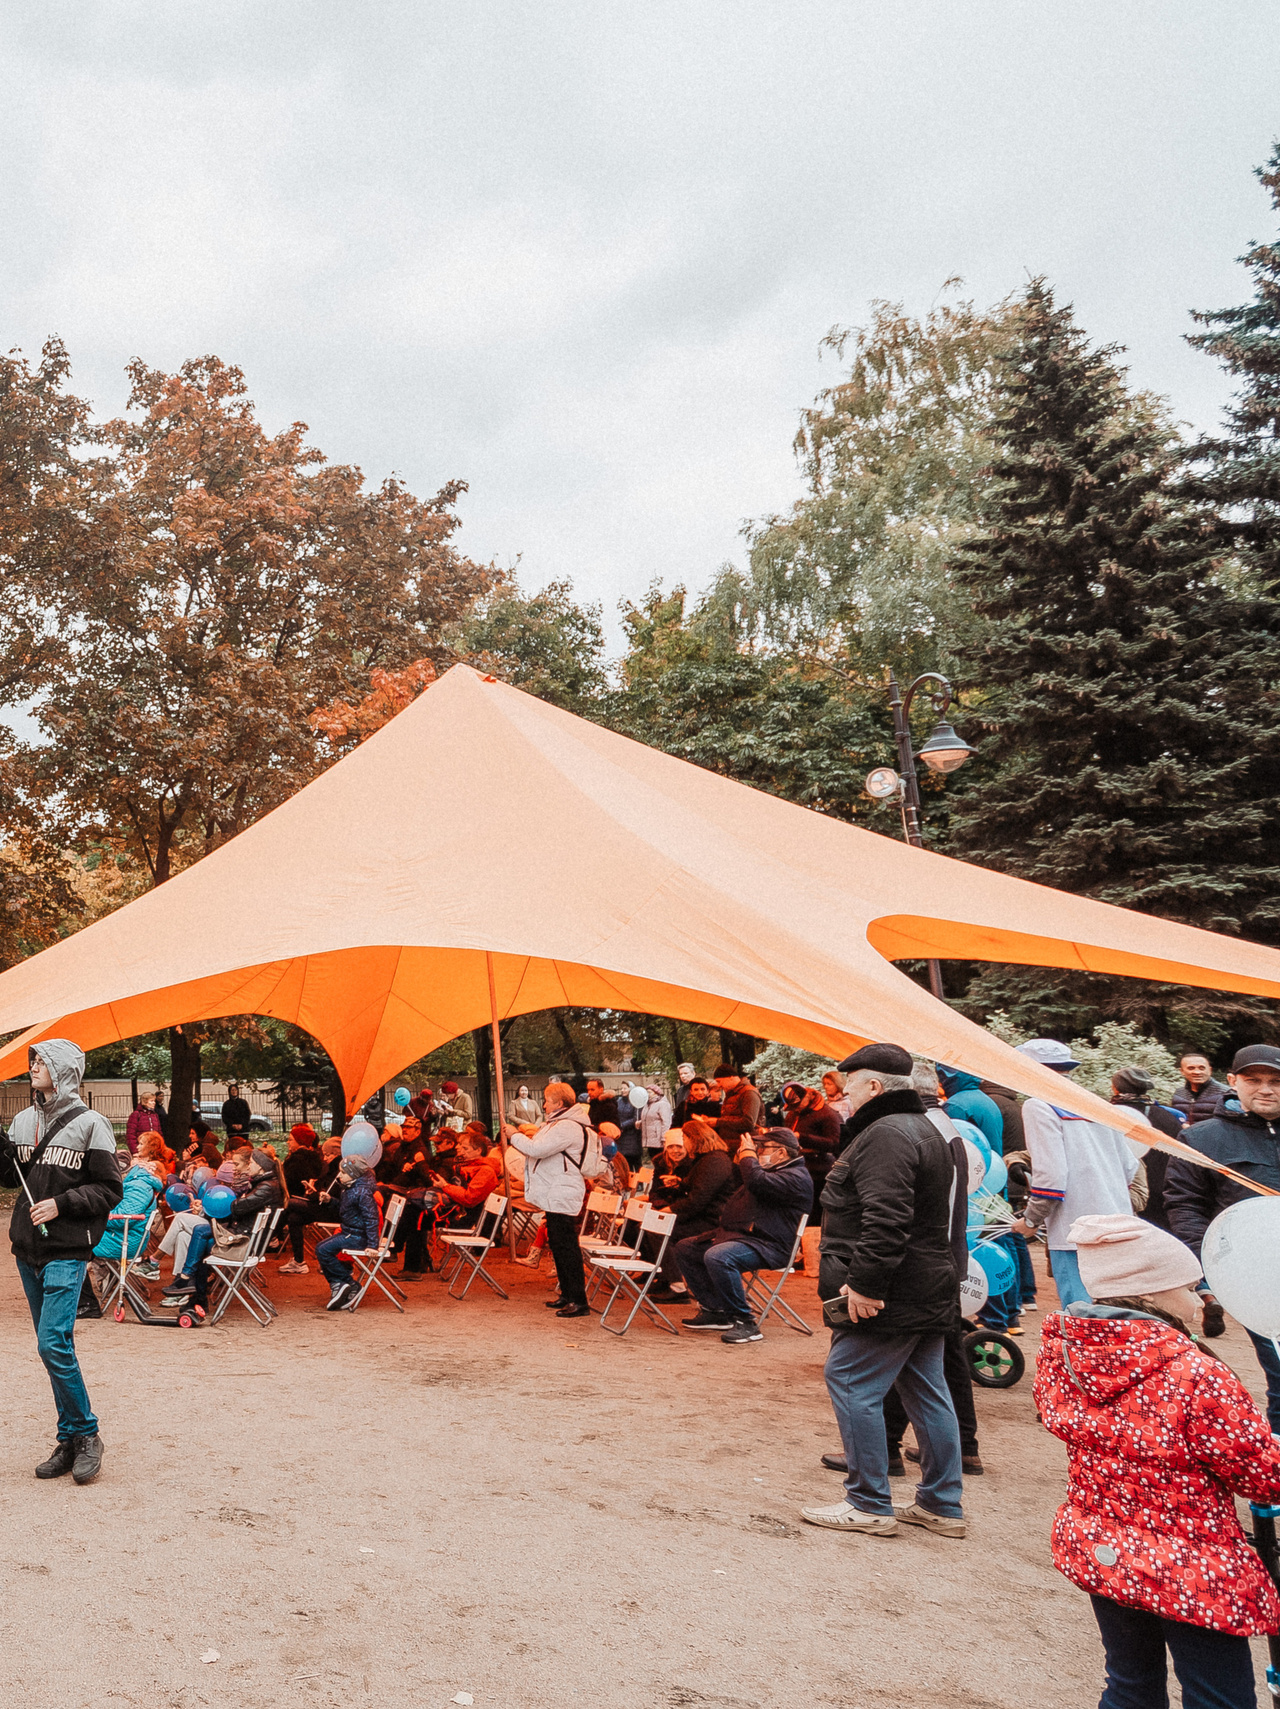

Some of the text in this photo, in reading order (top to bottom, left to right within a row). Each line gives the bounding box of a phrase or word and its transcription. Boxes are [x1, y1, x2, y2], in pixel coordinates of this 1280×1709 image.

[968, 1275, 985, 1288] ГАВА
[960, 1284, 983, 1300] 300 ЛЕ
